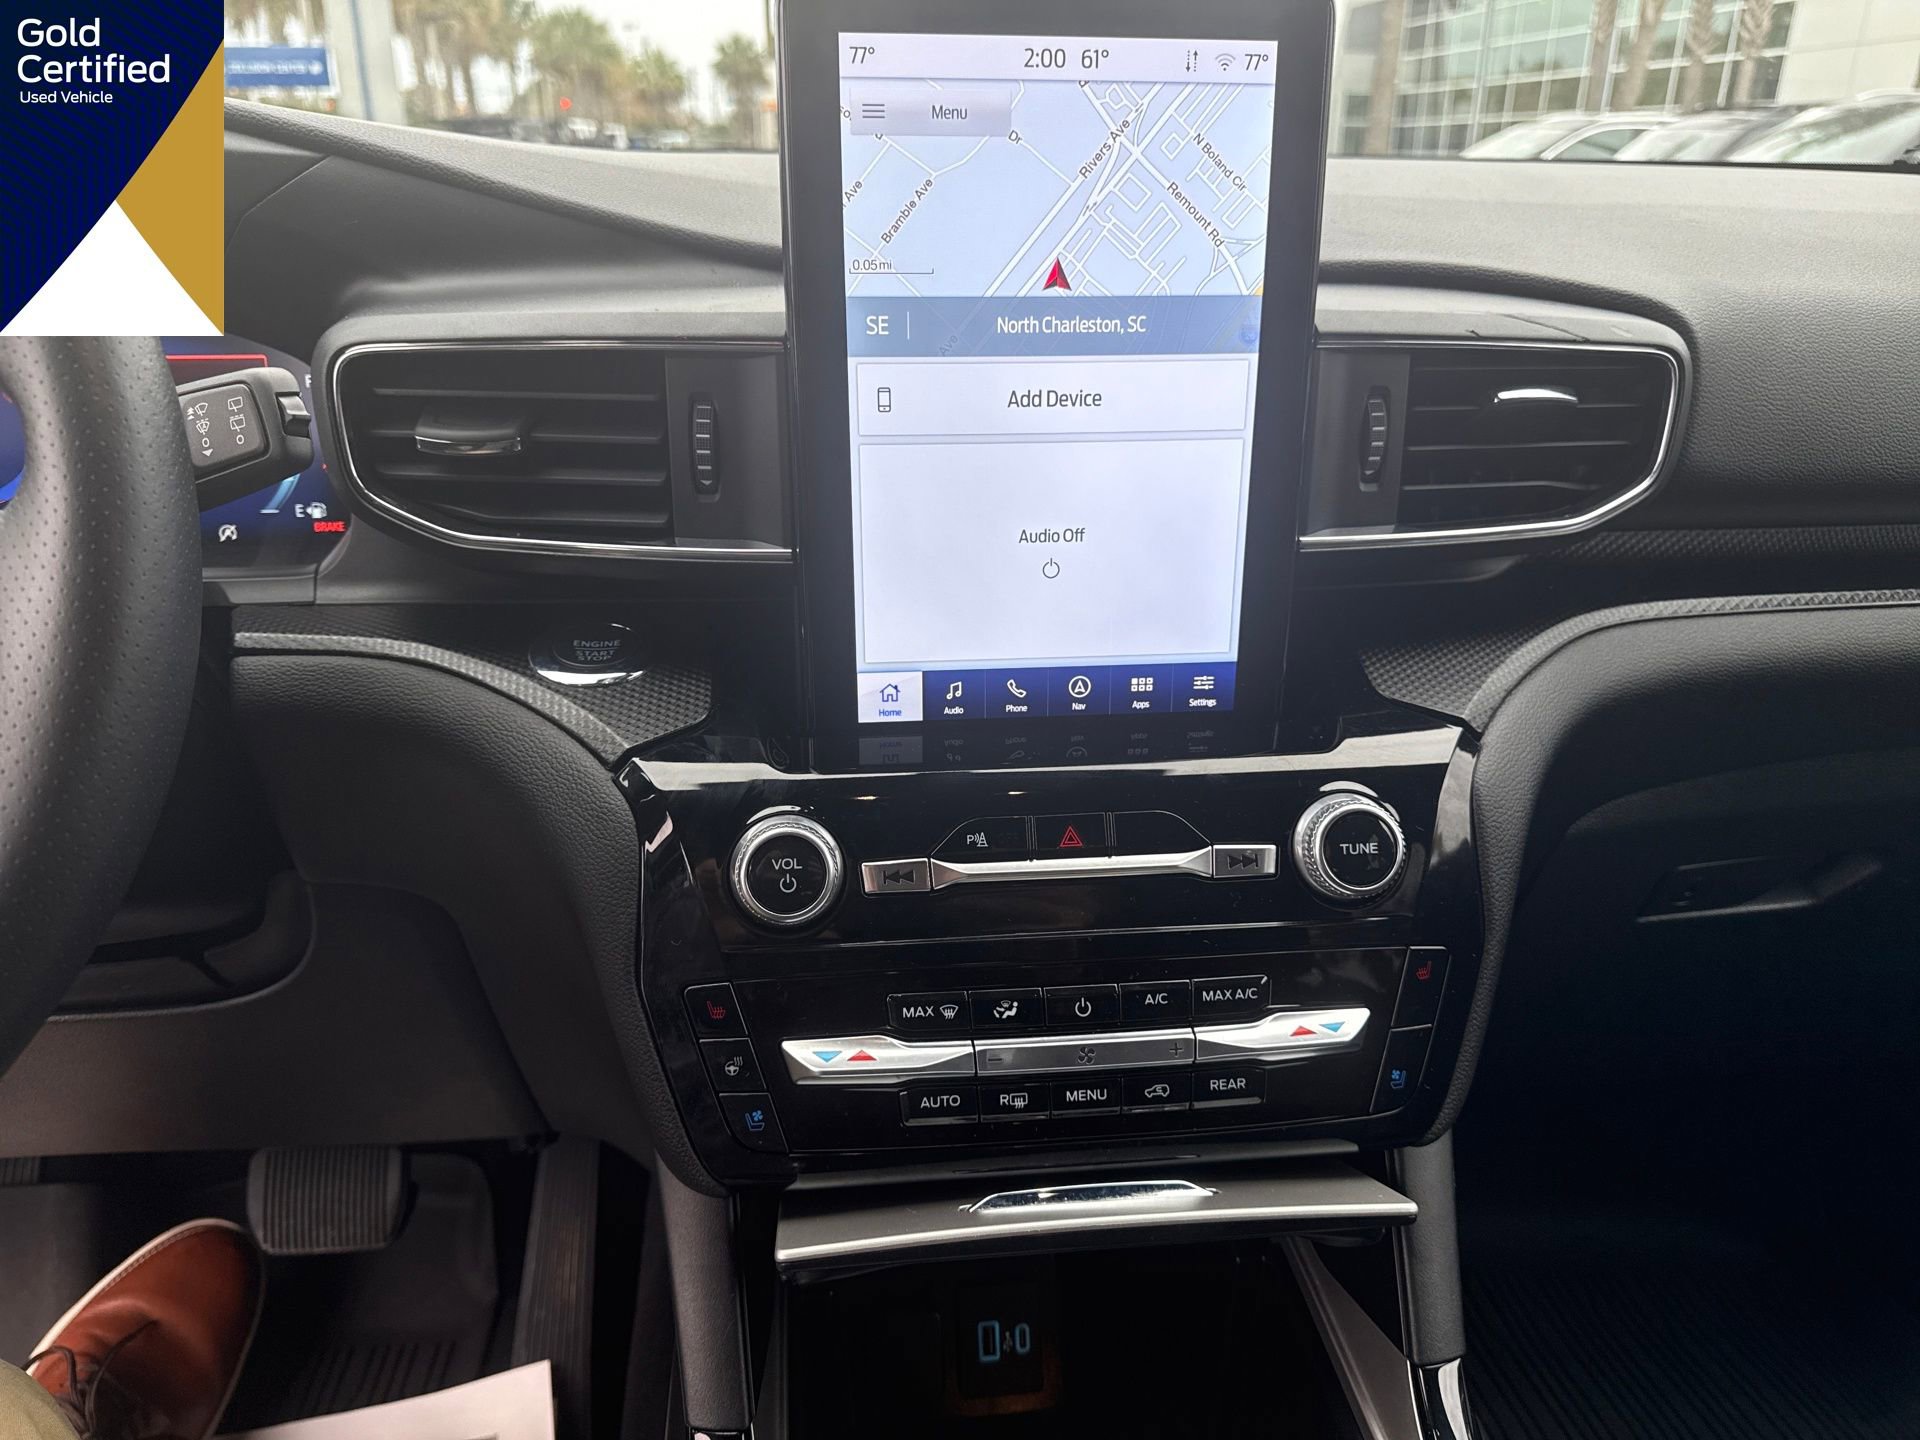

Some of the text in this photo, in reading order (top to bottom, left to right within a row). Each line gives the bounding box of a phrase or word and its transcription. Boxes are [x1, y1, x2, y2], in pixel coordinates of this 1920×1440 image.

[849, 46, 875, 65] 77°
[1024, 48, 1066, 68] 2:00
[1081, 49, 1109, 69] 61°
[1244, 54, 1269, 71] 77°
[931, 104, 968, 120] Menu
[1008, 130, 1023, 146] Dr
[1078, 119, 1131, 179] Rivers Ave
[1193, 132, 1248, 193] N Boland Cir
[844, 180, 863, 202] Ave
[880, 178, 933, 245] Bramble Ave
[1166, 181, 1225, 248] Remount Rd
[852, 259, 892, 271] 0.05 mi
[866, 315, 889, 335] SE
[996, 314, 1146, 335] North Charleston, SC
[1007, 389, 1102, 409] Add Device
[294, 503, 306, 518] E
[312, 520, 347, 533] BRAKE
[1018, 528, 1085, 544] Audio Off
[572, 639, 621, 648] ENGINE
[575, 649, 615, 657] START
[943, 706, 964, 715] Audio
[1005, 704, 1028, 713] Phone
[1071, 702, 1086, 711] Nav
[1131, 700, 1150, 710] Apps
[1188, 698, 1217, 708] Settings
[878, 708, 902, 718] Home
[1339, 842, 1379, 855] TUNE
[771, 858, 802, 870] VOL
[1144, 992, 1169, 1006] A/C
[1202, 987, 1258, 1002] MAX A/C
[902, 1005, 934, 1019] MAX
[1209, 1078, 1246, 1091] REAR
[919, 1094, 961, 1109] AUTO
[1066, 1089, 1107, 1102] MENU
